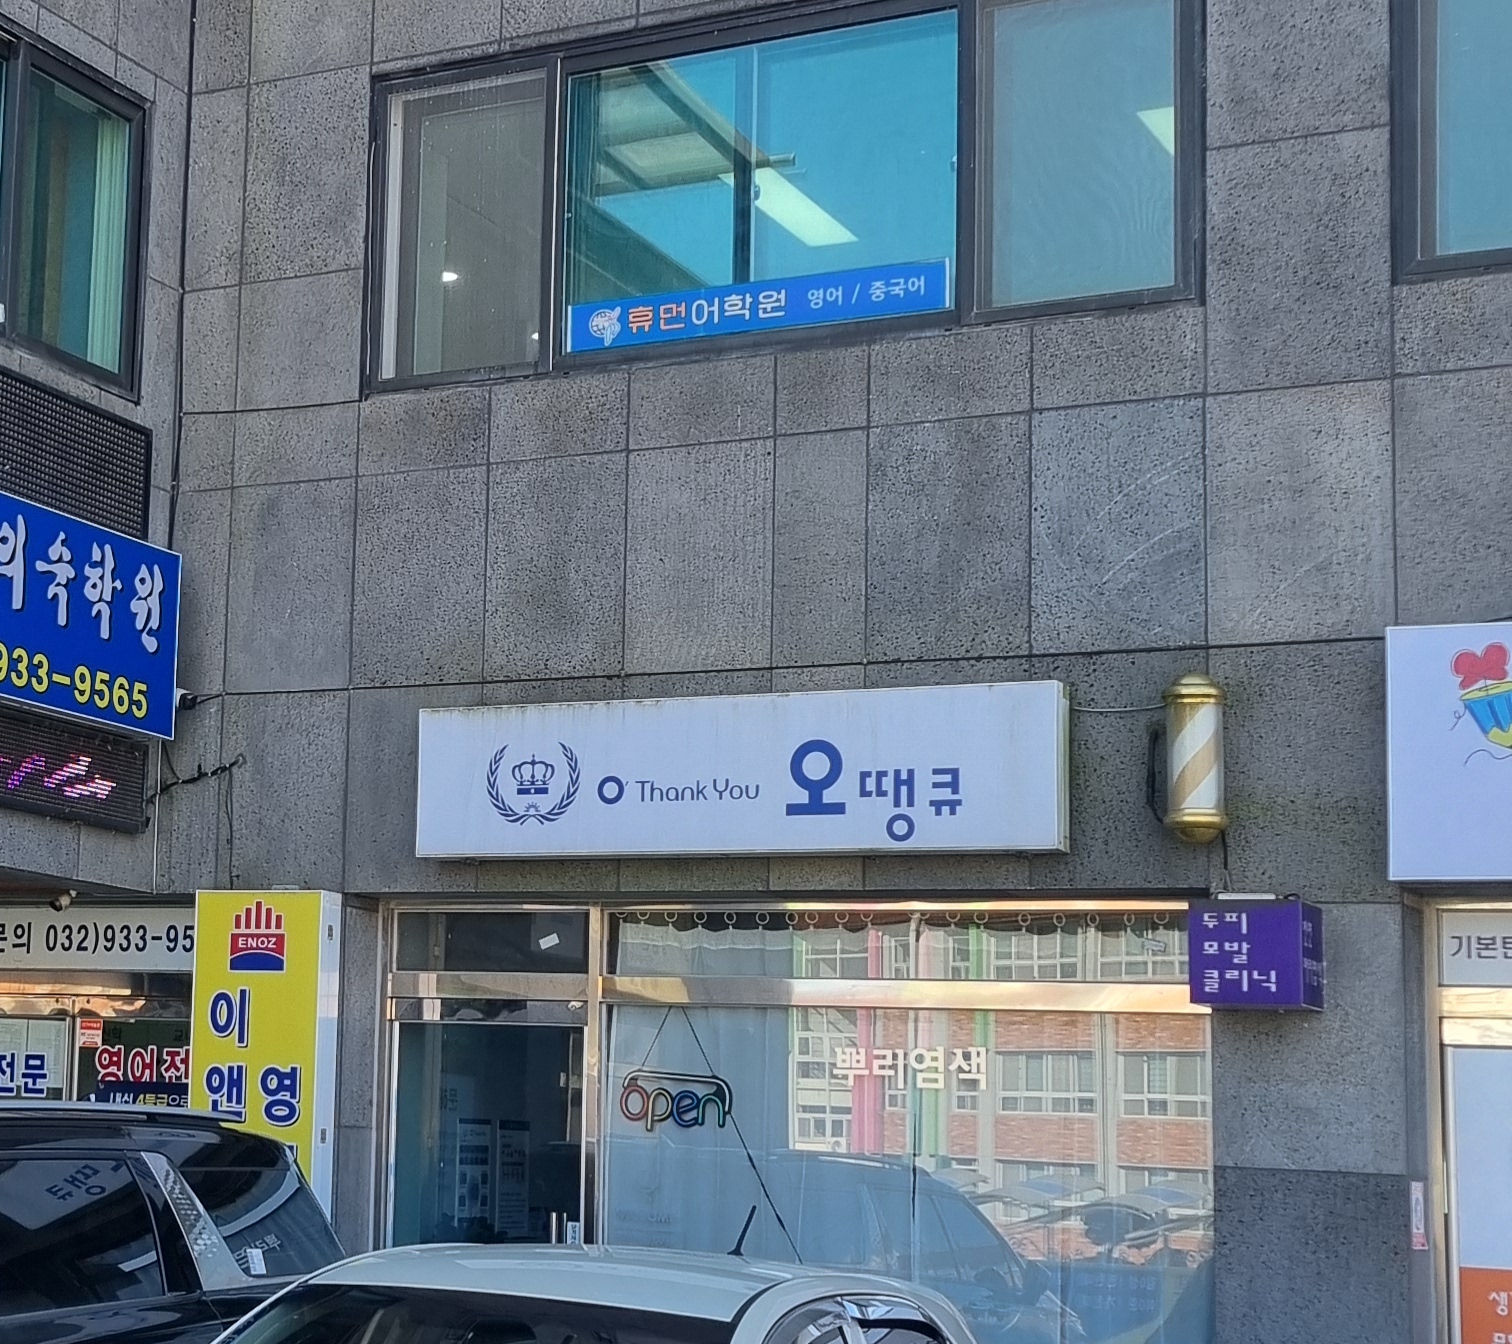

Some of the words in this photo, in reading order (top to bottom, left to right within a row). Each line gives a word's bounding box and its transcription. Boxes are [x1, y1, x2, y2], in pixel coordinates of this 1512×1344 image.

[627, 288, 788, 335] 휴먼어학원
[806, 284, 844, 309] 영어
[868, 275, 927, 304] 중국어
[635, 778, 709, 803] Thank
[712, 776, 761, 802] You
[1201, 912, 1248, 935] 두피
[238, 936, 277, 950] ENOZ
[1201, 941, 1251, 964] 모발
[1203, 969, 1277, 993] 클리닉
[832, 1045, 987, 1091] 뿌리염색
[620, 1084, 726, 1132] open
